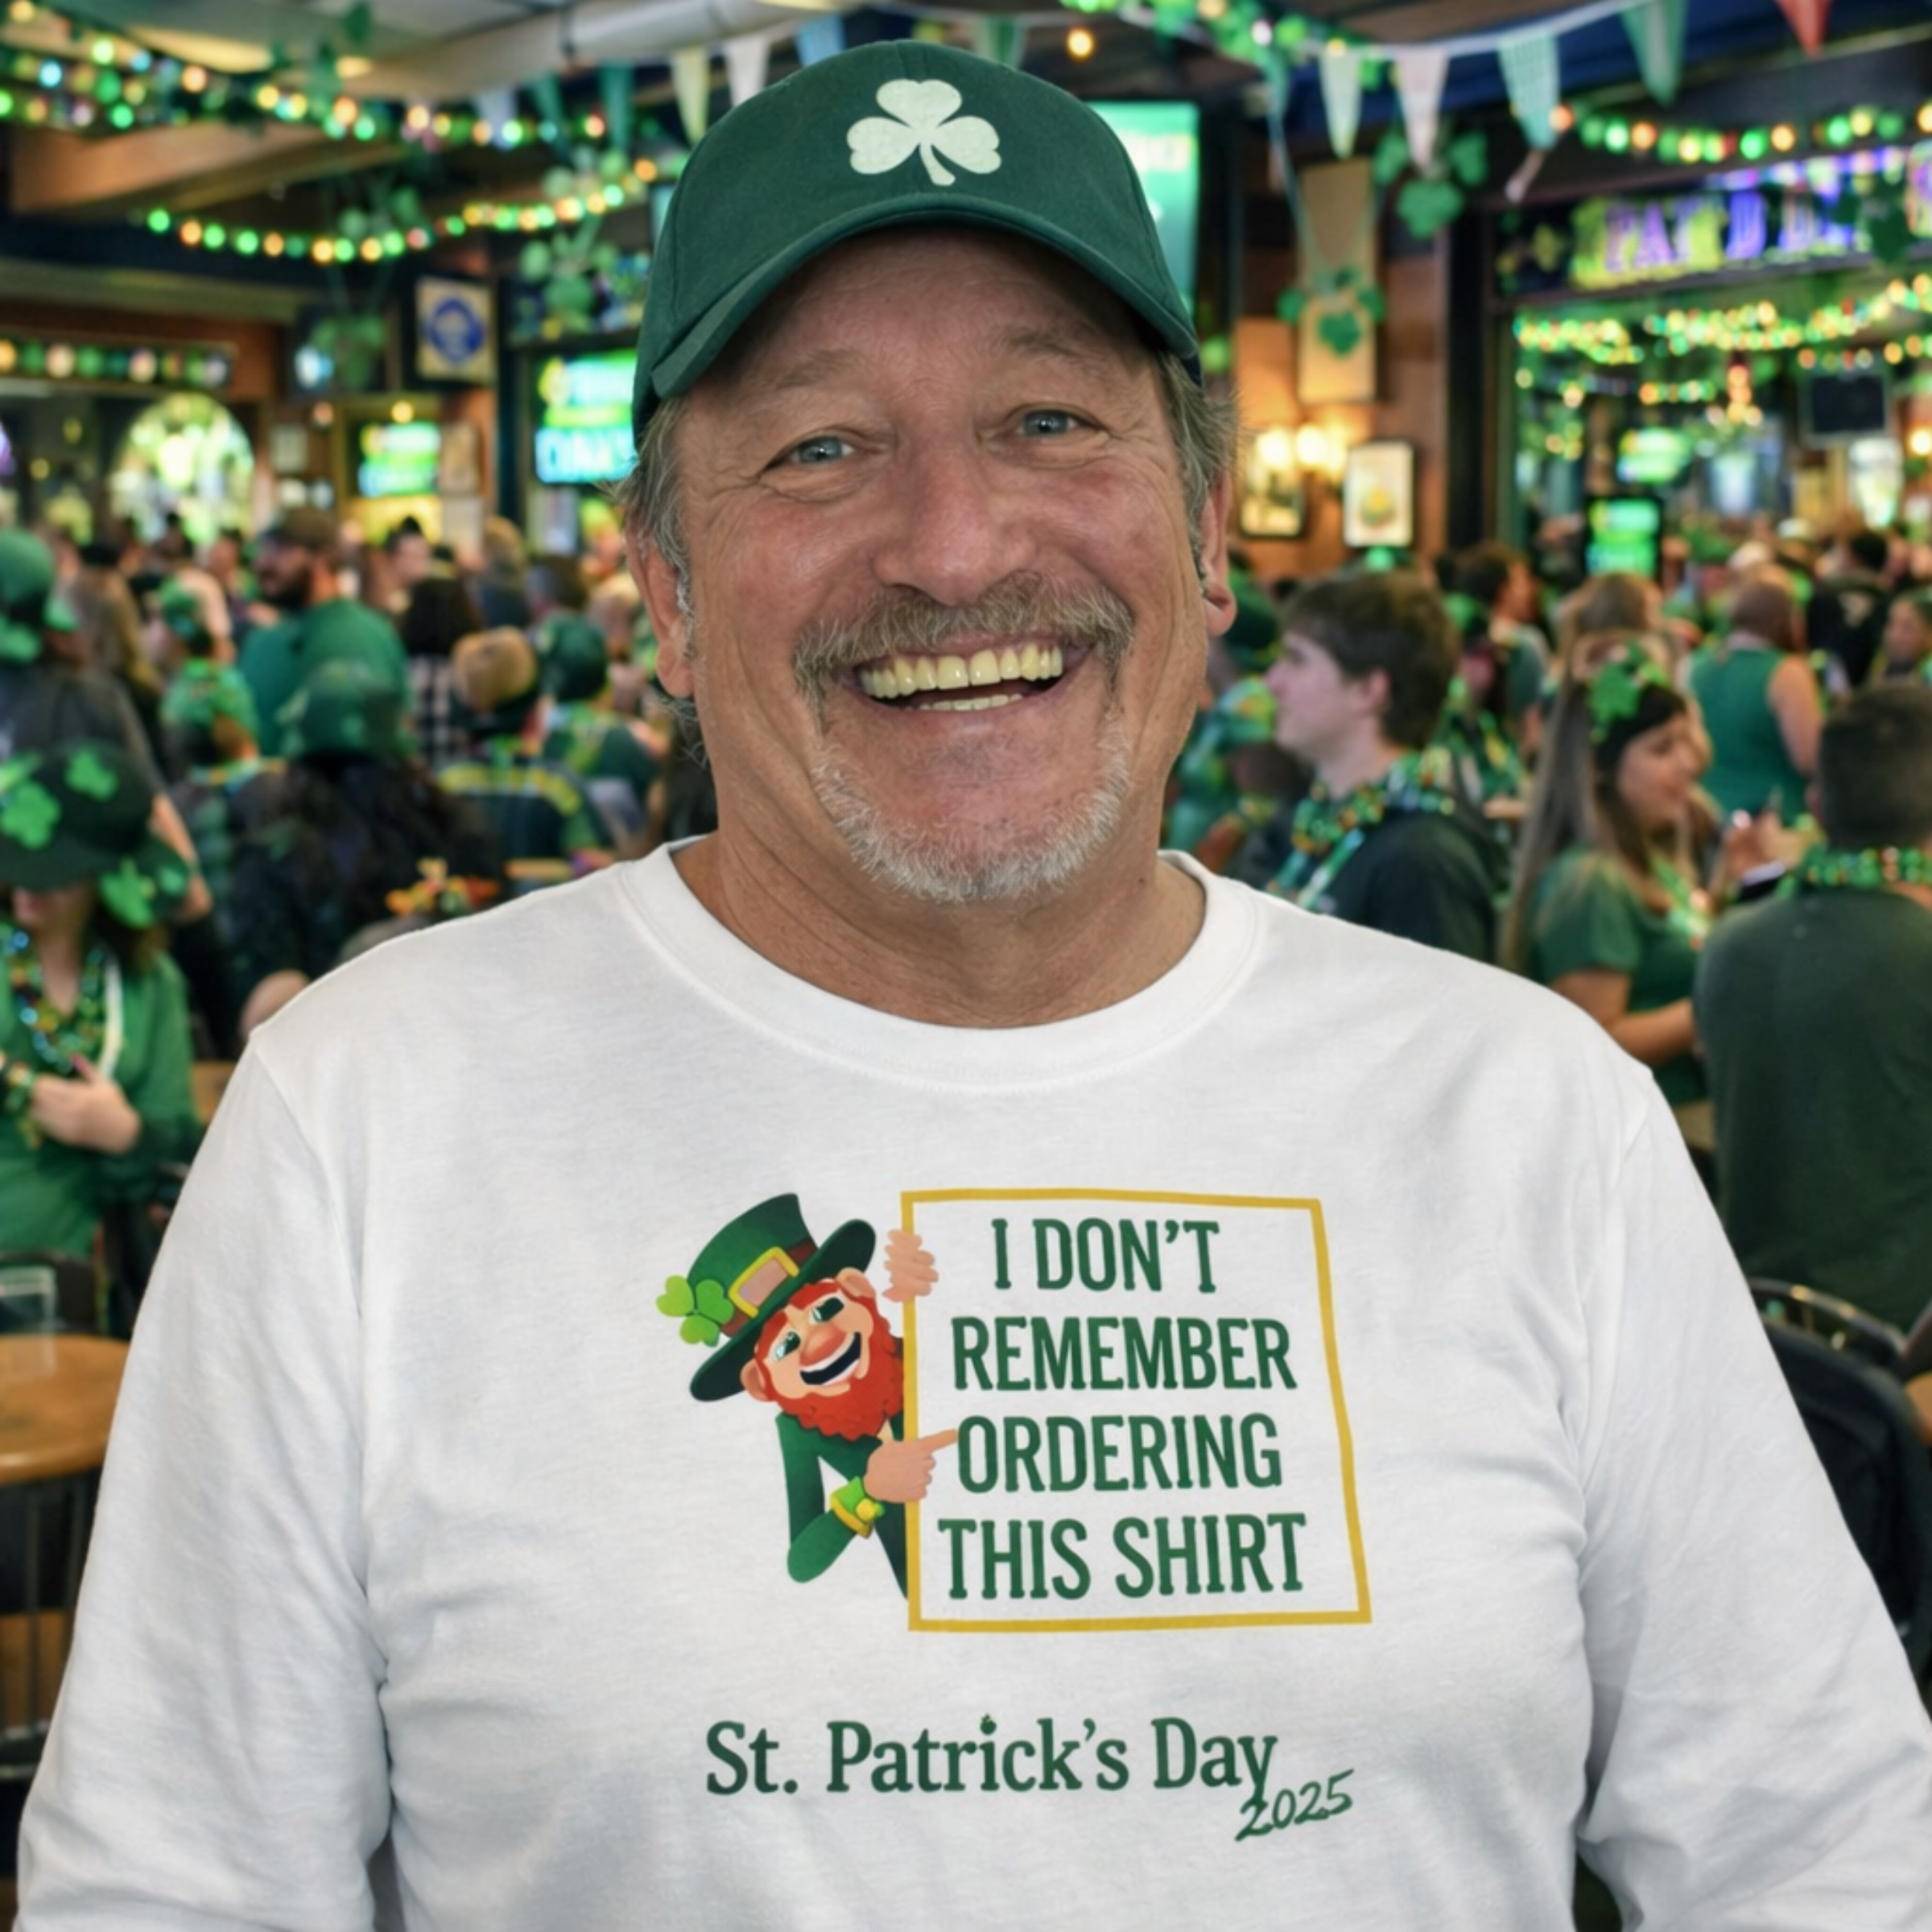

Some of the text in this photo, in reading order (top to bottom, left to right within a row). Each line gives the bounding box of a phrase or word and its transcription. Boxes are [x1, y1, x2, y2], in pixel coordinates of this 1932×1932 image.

[992, 1217, 1011, 1290] I
[950, 1315, 1298, 1392] REMEMBER
[956, 1413, 1282, 1494] ORDERING
[937, 1512, 1307, 1600] THIS SHIRT
[705, 1720, 799, 1795] St.
[1151, 1715, 1278, 1805] Day
[1234, 1768, 1355, 1843] 2025
